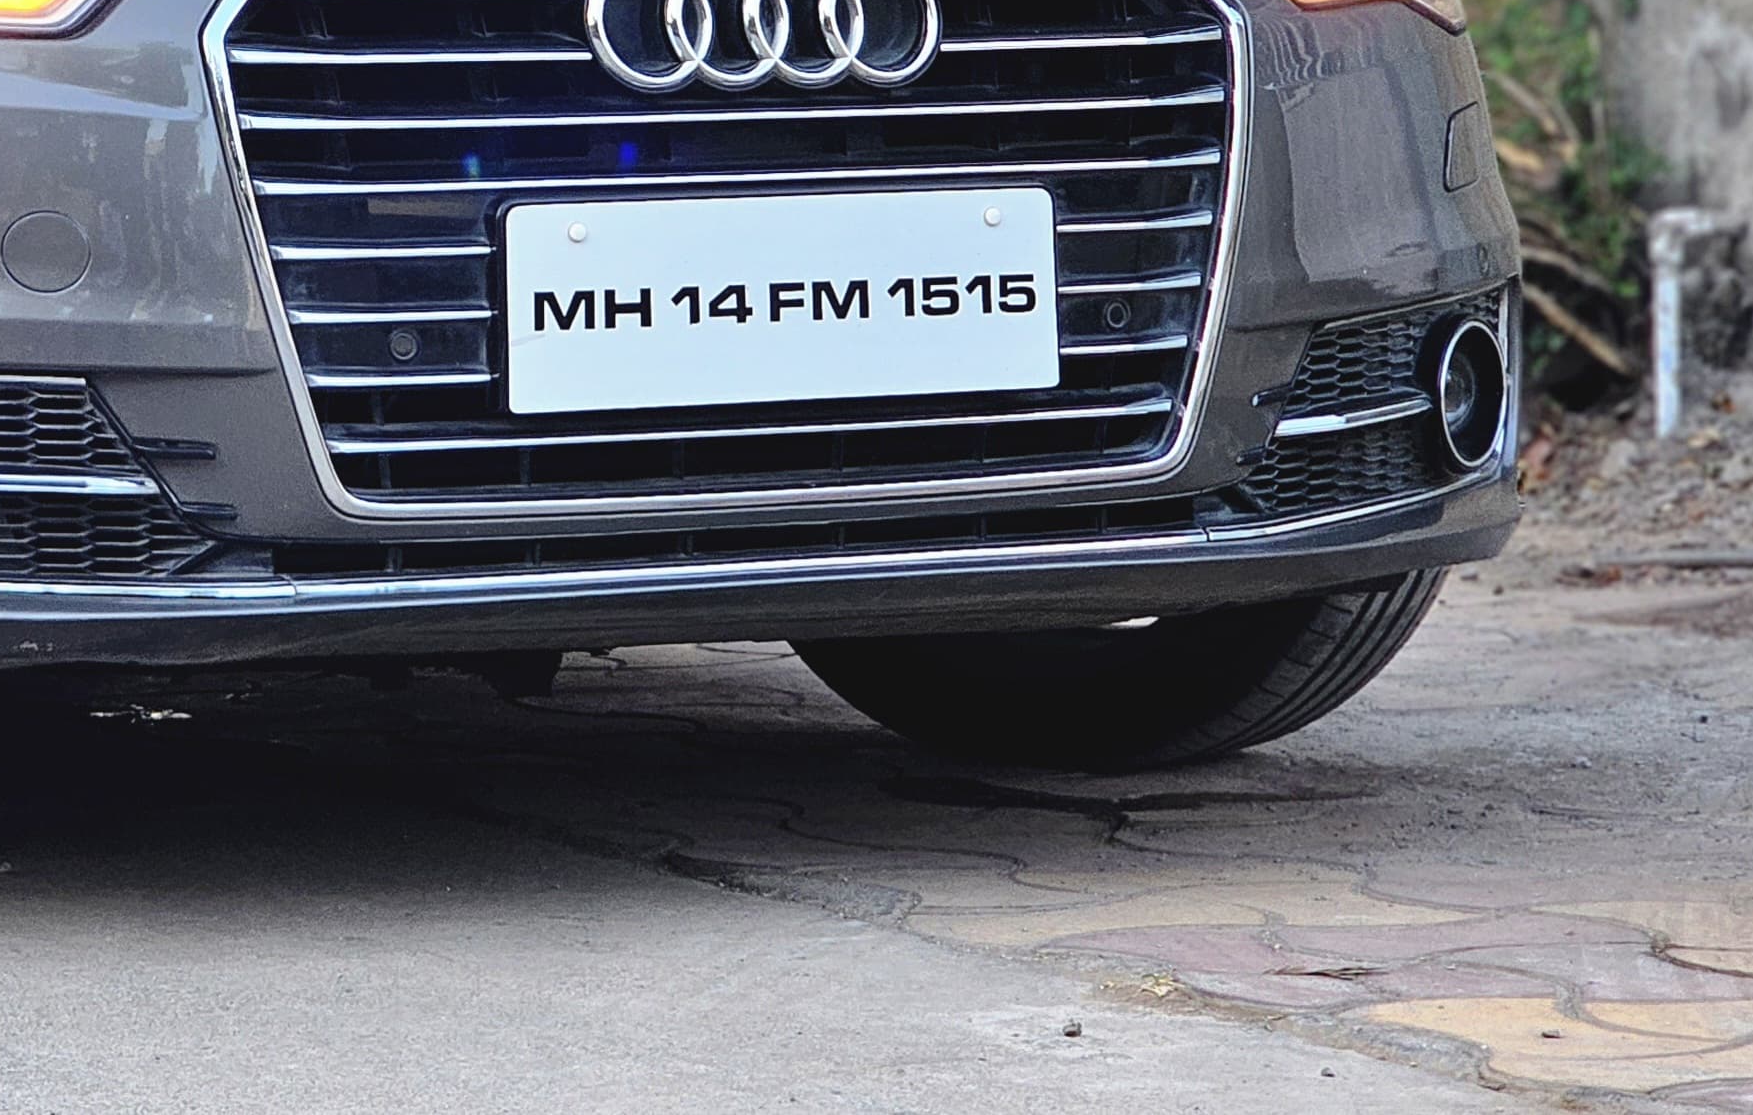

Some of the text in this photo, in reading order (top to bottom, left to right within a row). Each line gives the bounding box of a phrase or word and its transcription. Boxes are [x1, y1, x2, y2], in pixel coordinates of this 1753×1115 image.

[533, 273, 1036, 332] MH 14 FM 1515
